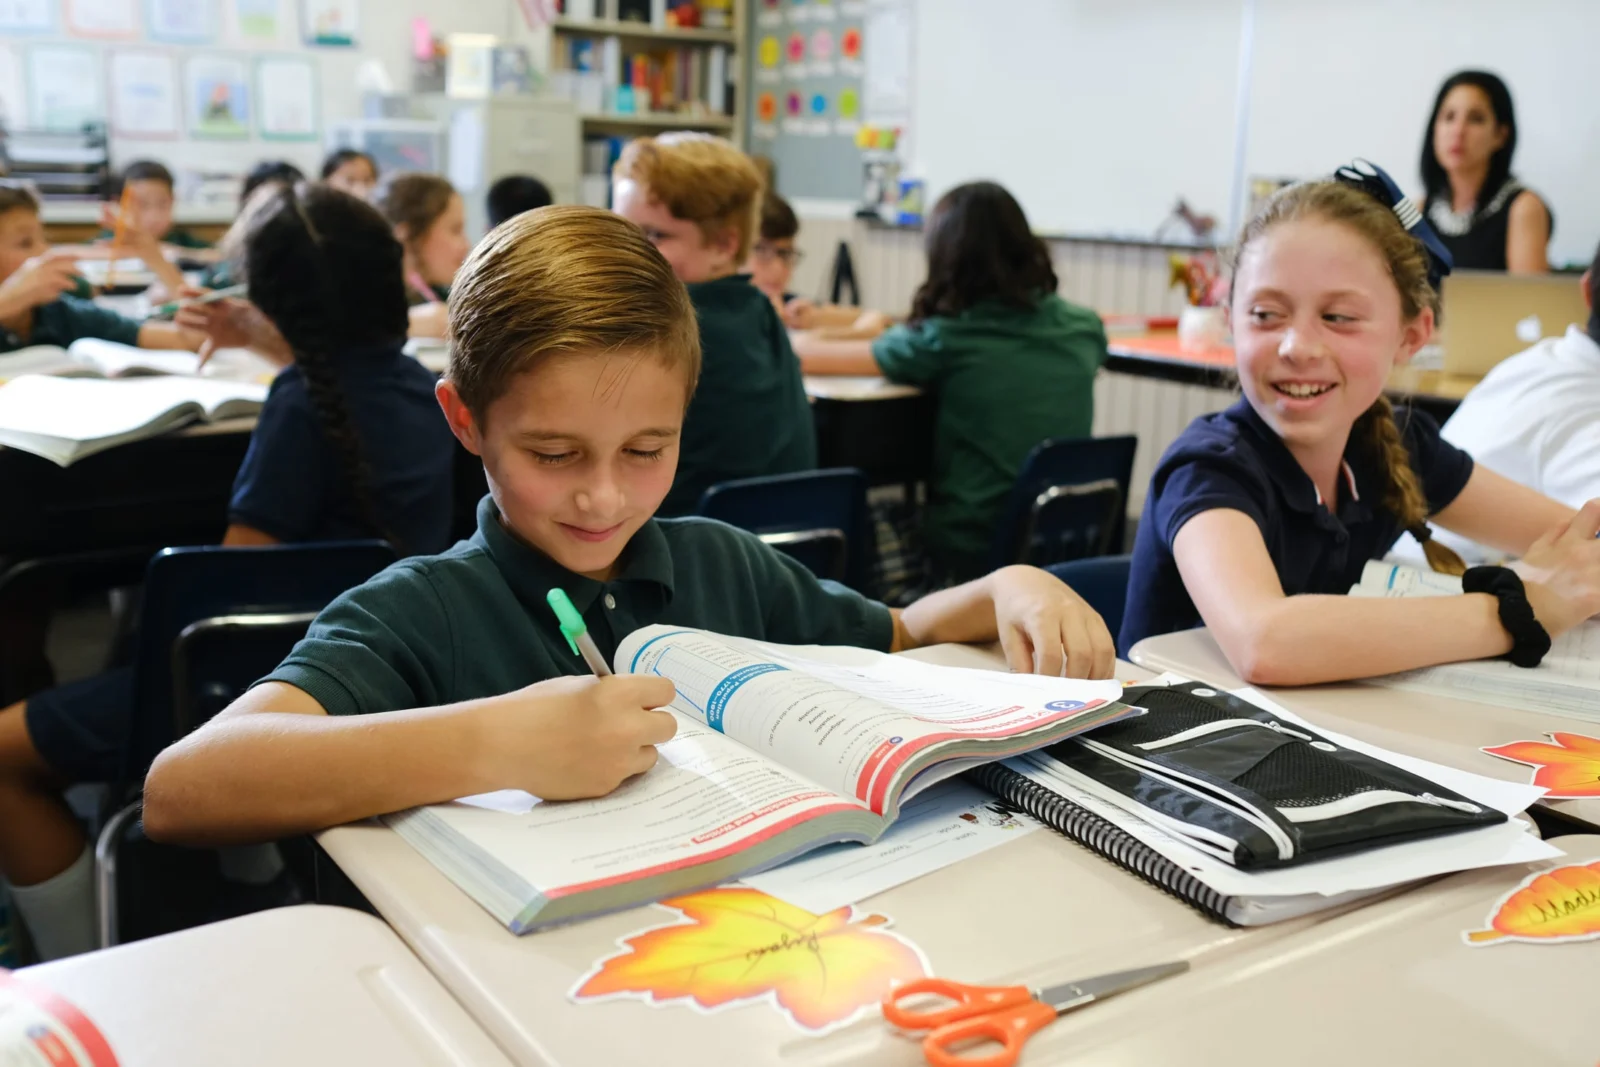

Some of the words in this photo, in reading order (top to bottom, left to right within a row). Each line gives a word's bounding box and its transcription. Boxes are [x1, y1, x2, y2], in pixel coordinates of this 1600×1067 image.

[715, 681, 739, 720] Population
[779, 710, 788, 720] did
[798, 705, 818, 723] kinship
[808, 709, 827, 726] colony
[770, 719, 780, 734] they
[814, 714, 836, 733] republic
[818, 718, 846, 746] indigenous
[755, 797, 796, 816] Thinking
[733, 812, 755, 827] and
[696, 824, 734, 843] Writing
